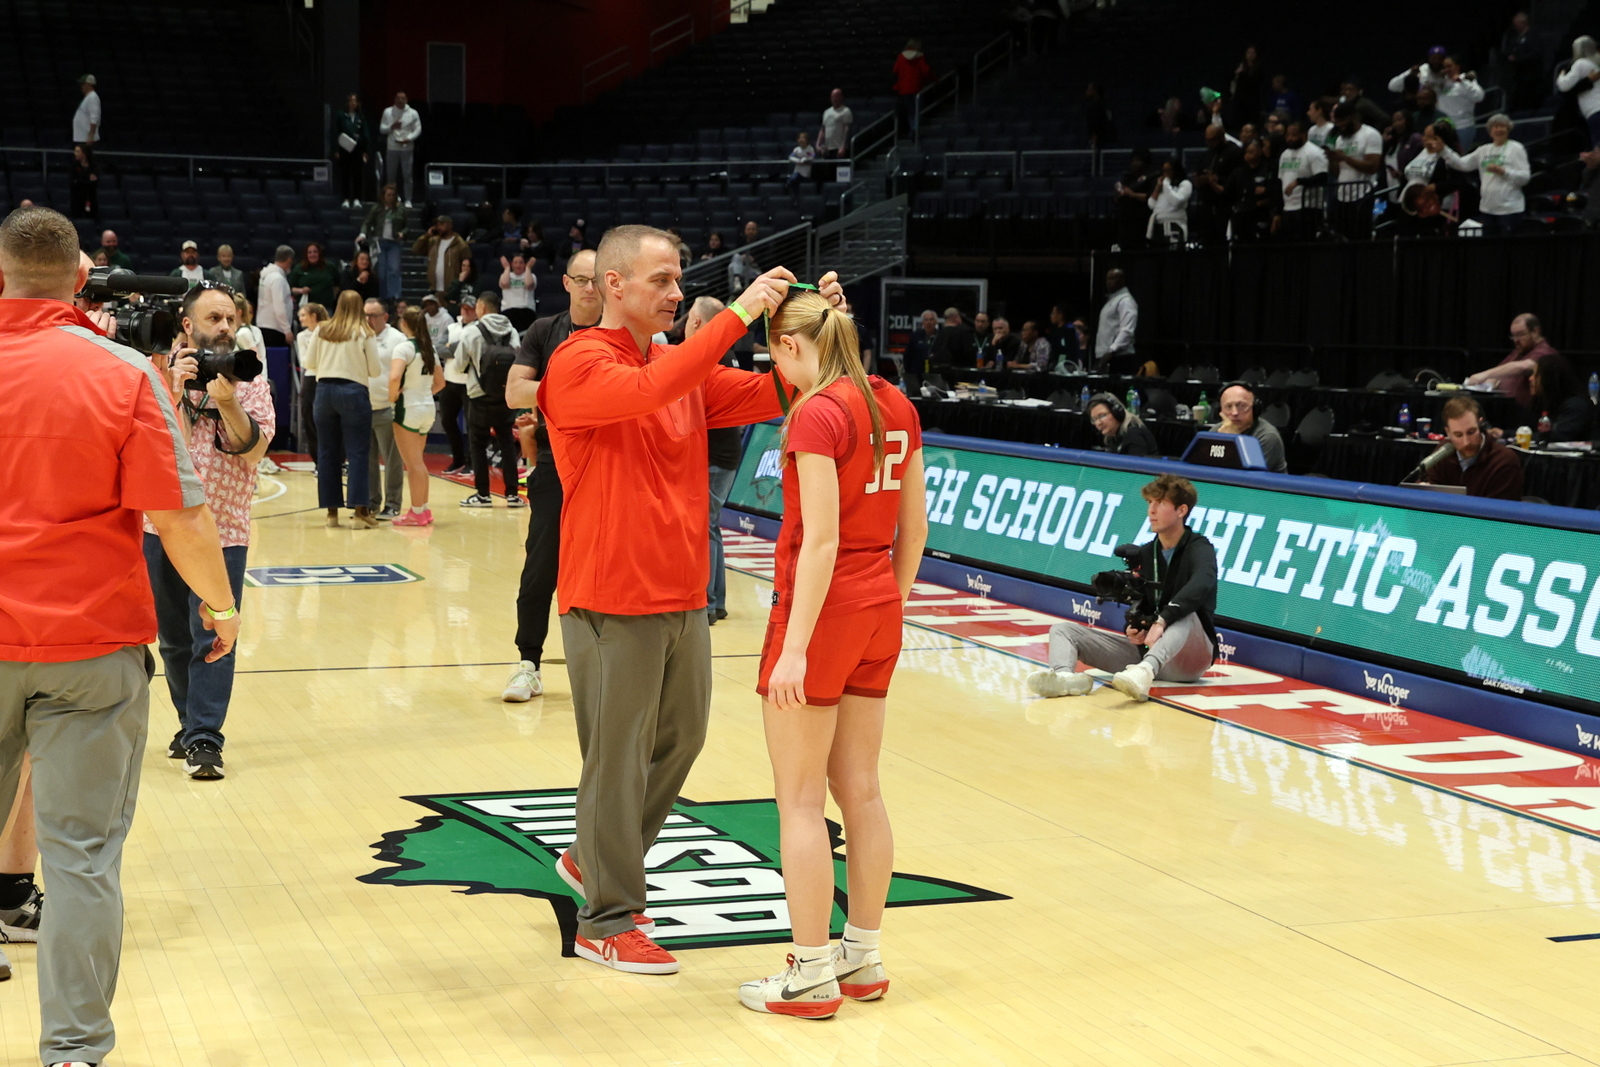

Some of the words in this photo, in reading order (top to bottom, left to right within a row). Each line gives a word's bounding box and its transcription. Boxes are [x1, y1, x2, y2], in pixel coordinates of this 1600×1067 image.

[1209, 444, 1226, 458] POSS
[963, 473, 1124, 558] SCHOOL
[1080, 599, 1102, 625] Kroger
[1216, 632, 1237, 660] oger
[1377, 673, 1410, 705] Kroger
[1482, 678, 1525, 695] DAKTRONICS
